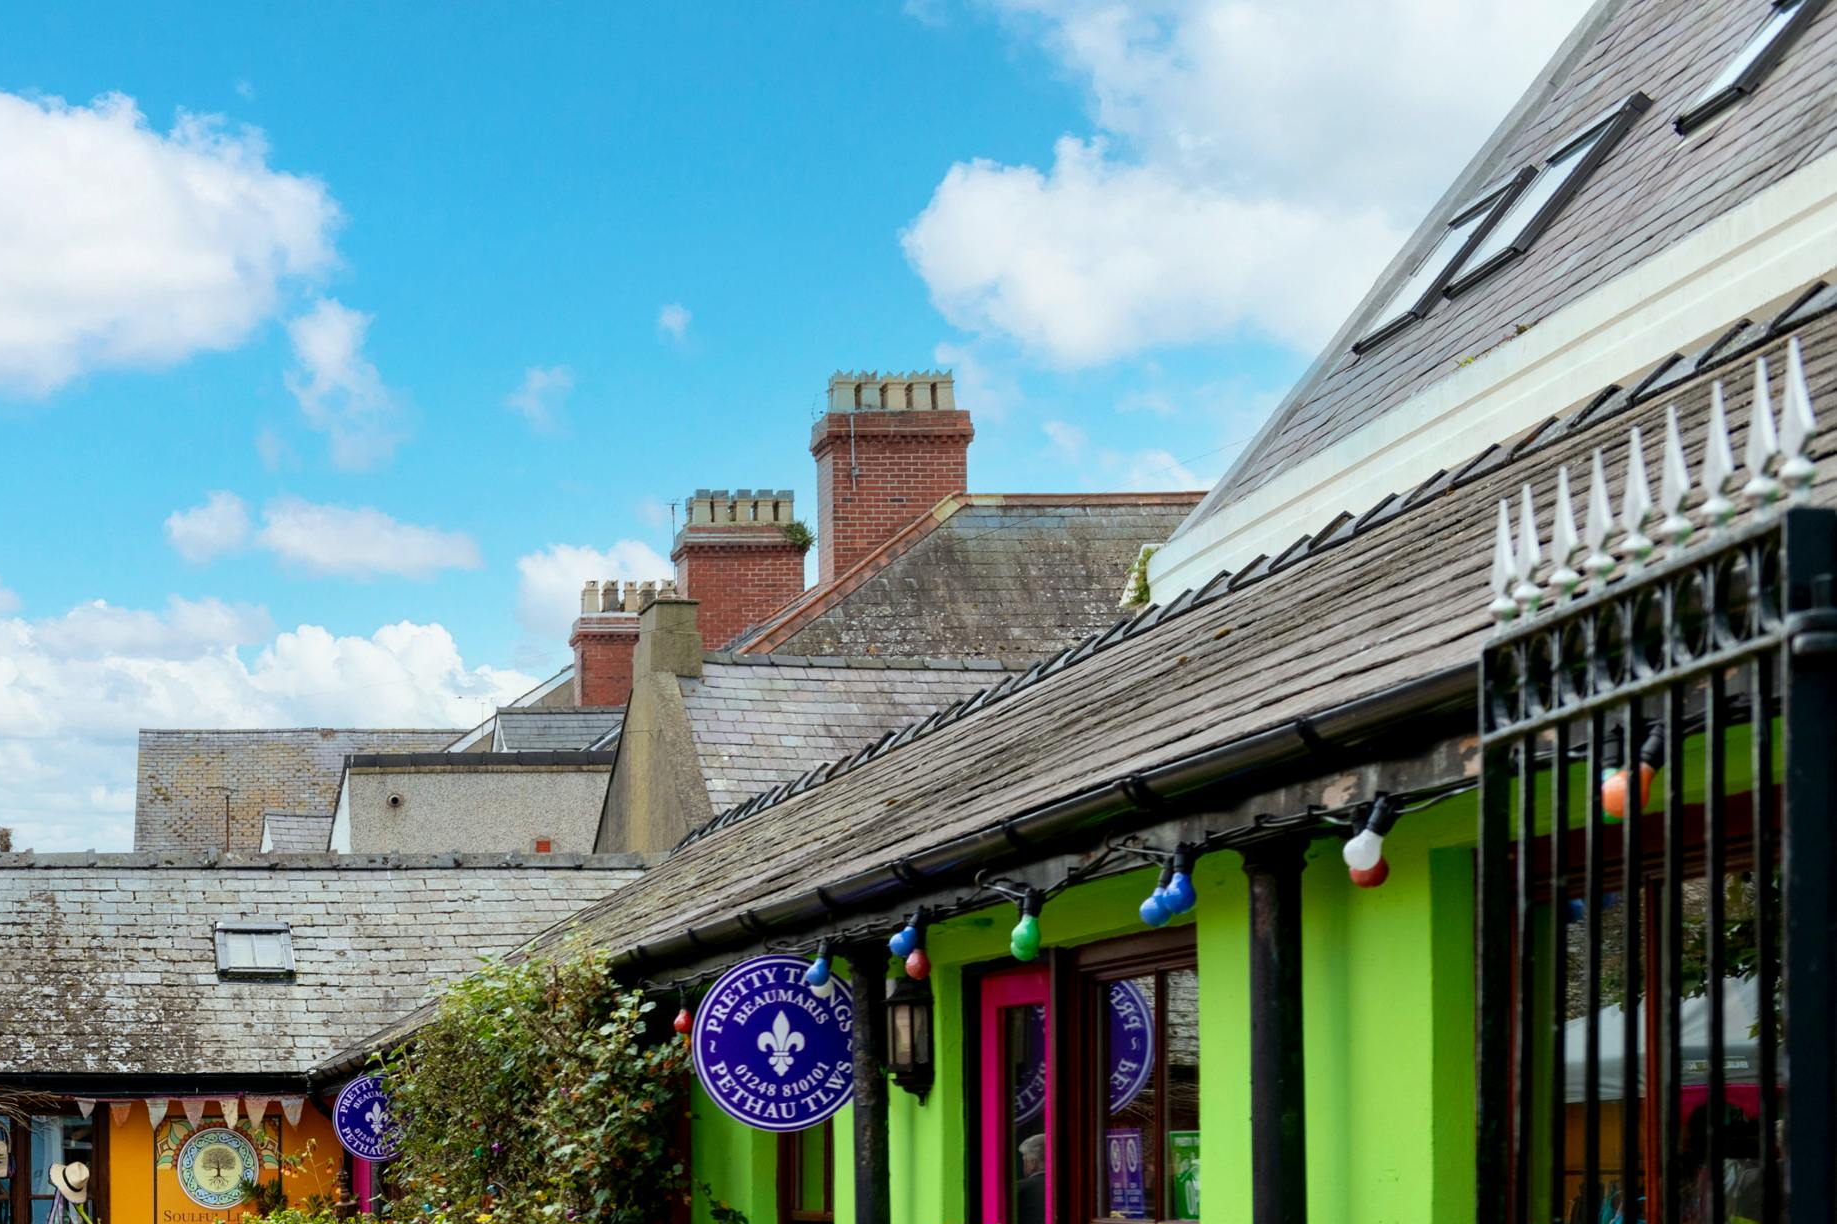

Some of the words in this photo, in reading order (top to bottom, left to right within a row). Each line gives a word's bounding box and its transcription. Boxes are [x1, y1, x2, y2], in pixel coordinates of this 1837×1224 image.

[705, 966, 779, 1034] PRETTY
[783, 966, 853, 1032] TNGS
[732, 988, 830, 1027] BEAUMARIS
[339, 1079, 375, 1114] PRETTY
[708, 1060, 797, 1119] PETHAU
[734, 1064, 777, 1097] 01248
[782, 1061, 831, 1097] 810101
[341, 1126, 386, 1155] PETHAU
[354, 1127, 376, 1145] 01248
